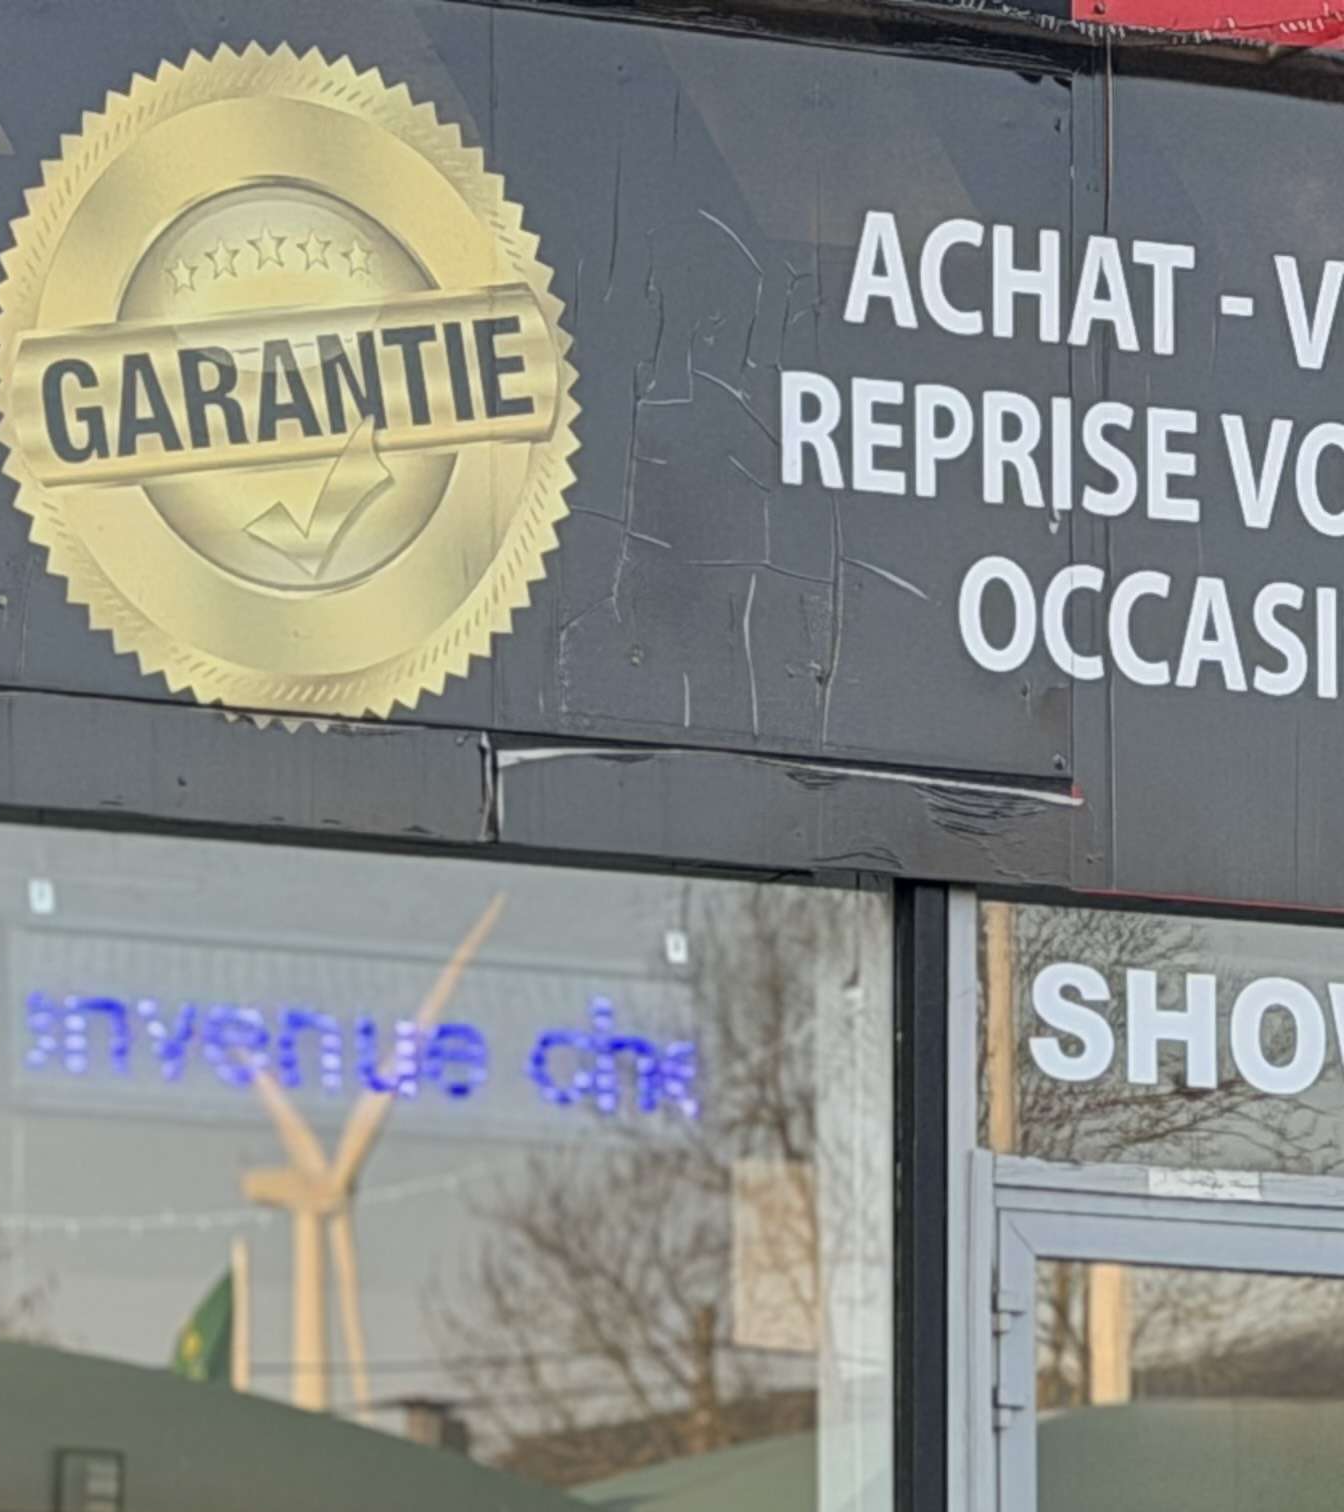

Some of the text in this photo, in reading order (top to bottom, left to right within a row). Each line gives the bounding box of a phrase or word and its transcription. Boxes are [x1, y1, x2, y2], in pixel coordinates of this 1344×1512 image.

[843, 210, 1196, 356] ACHAT
[1272, 254, 1344, 370] V
[40, 314, 536, 466] GARANTIE
[780, 369, 1344, 537] REPRISE VO
[958, 555, 1339, 700] OCCASI
[1029, 962, 1344, 1095] SHO
